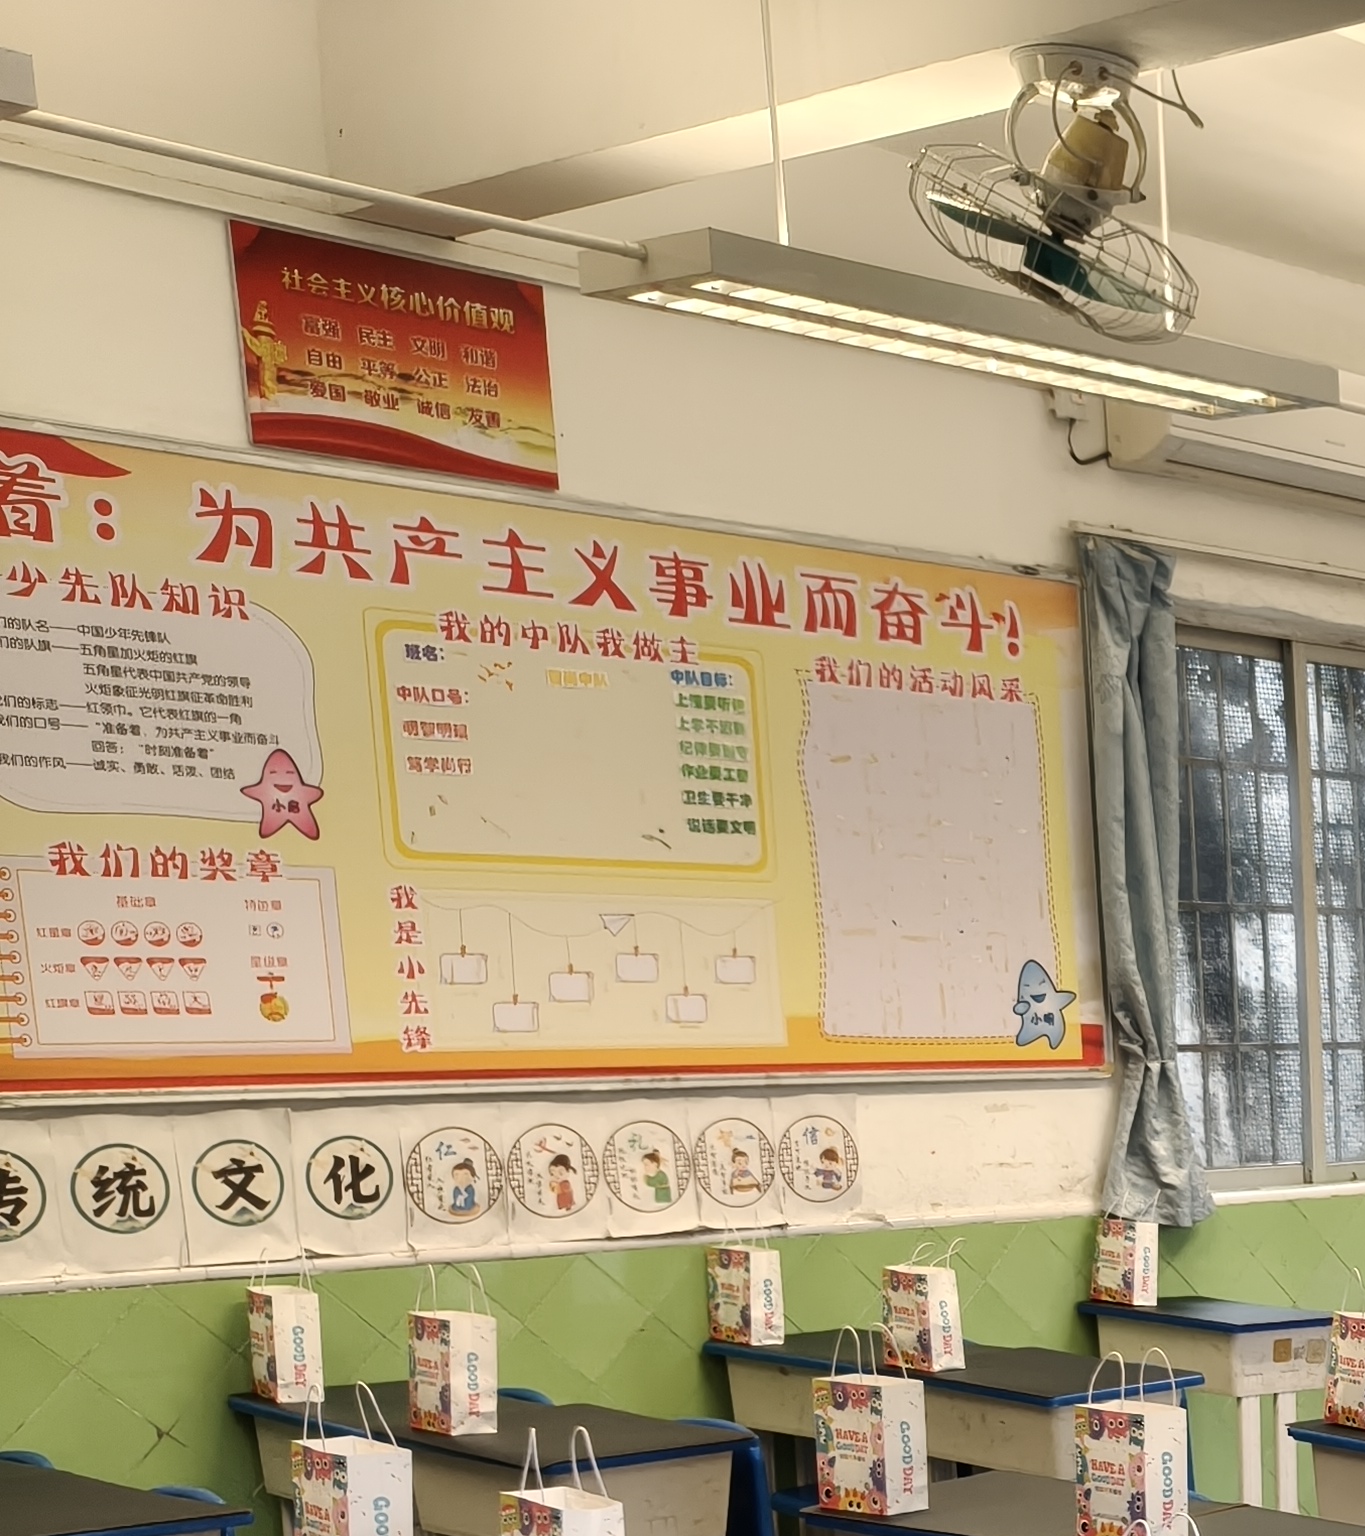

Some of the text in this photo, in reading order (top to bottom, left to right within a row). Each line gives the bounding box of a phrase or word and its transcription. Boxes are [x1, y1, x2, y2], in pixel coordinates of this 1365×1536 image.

[282, 267, 516, 334] 社会主义核心价值观
[302, 314, 497, 370] 富强 民主 文明 和谐
[307, 349, 498, 397] 自由 平等 公正 法治
[309, 379, 500, 428] 爱国 敬业 诚信 友善
[6, 561, 250, 621] 少先队知识
[439, 610, 699, 665] 我的中队我做主
[813, 656, 1024, 703] 我们的活动风采
[48, 841, 284, 882] 我们的奖章
[390, 884, 431, 1051] 我是小先锋
[802, 1127, 820, 1145] 信
[835, 1428, 860, 1442] HAVE
[1091, 1459, 1116, 1475] HAVE
